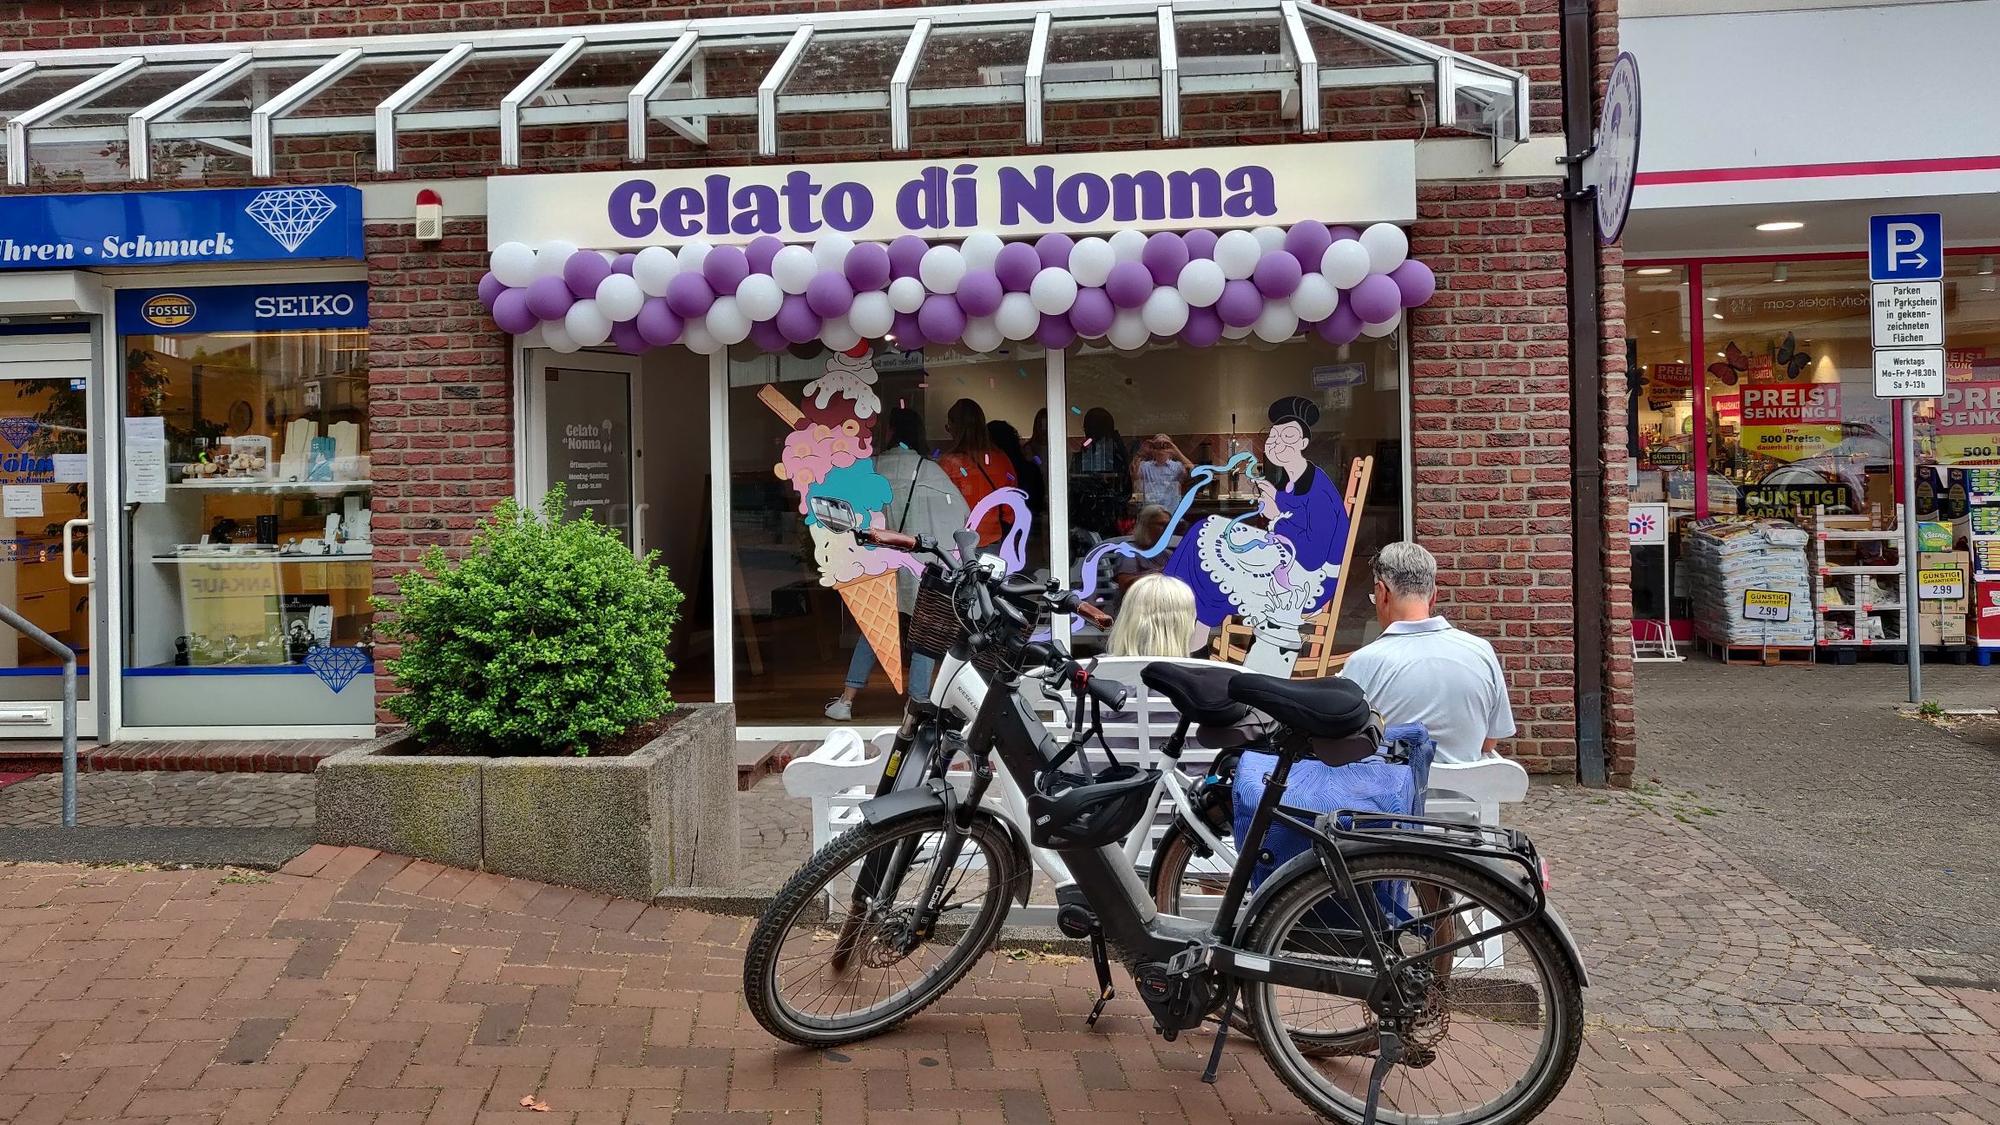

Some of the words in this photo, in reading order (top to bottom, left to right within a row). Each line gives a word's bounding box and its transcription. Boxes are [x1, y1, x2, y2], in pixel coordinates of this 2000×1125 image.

[608, 170, 874, 239] Gelato
[895, 164, 979, 230] di
[998, 165, 1278, 226] Nonna
[0, 239, 74, 261] hren
[101, 232, 234, 259] Schmuck
[1887, 223, 1925, 271] P
[1893, 286, 1921, 295] Parken
[255, 294, 353, 318] SEIKO
[1877, 298, 1891, 307] mit
[1894, 297, 1938, 307] Parkschein
[149, 306, 190, 316] FOSSIL
[1886, 311, 1894, 319] in
[1897, 310, 1931, 320] gekenn-
[1887, 321, 1930, 331] zeichneten
[1893, 333, 1924, 342] Flächen
[1893, 358, 1926, 366] Werktags
[1947, 352, 1982, 362] EIS!
[1658, 365, 1692, 375] PREI
[1893, 381, 1902, 389] Sa
[566, 424, 599, 437] Gelato
[1761, 435, 1782, 443] 500
[1785, 434, 1821, 443] Preise
[568, 438, 601, 450] Nonna
[1963, 446, 1992, 457] 500
[1932, 585, 1952, 595] 2.99
[1759, 606, 1778, 616] 2.99
